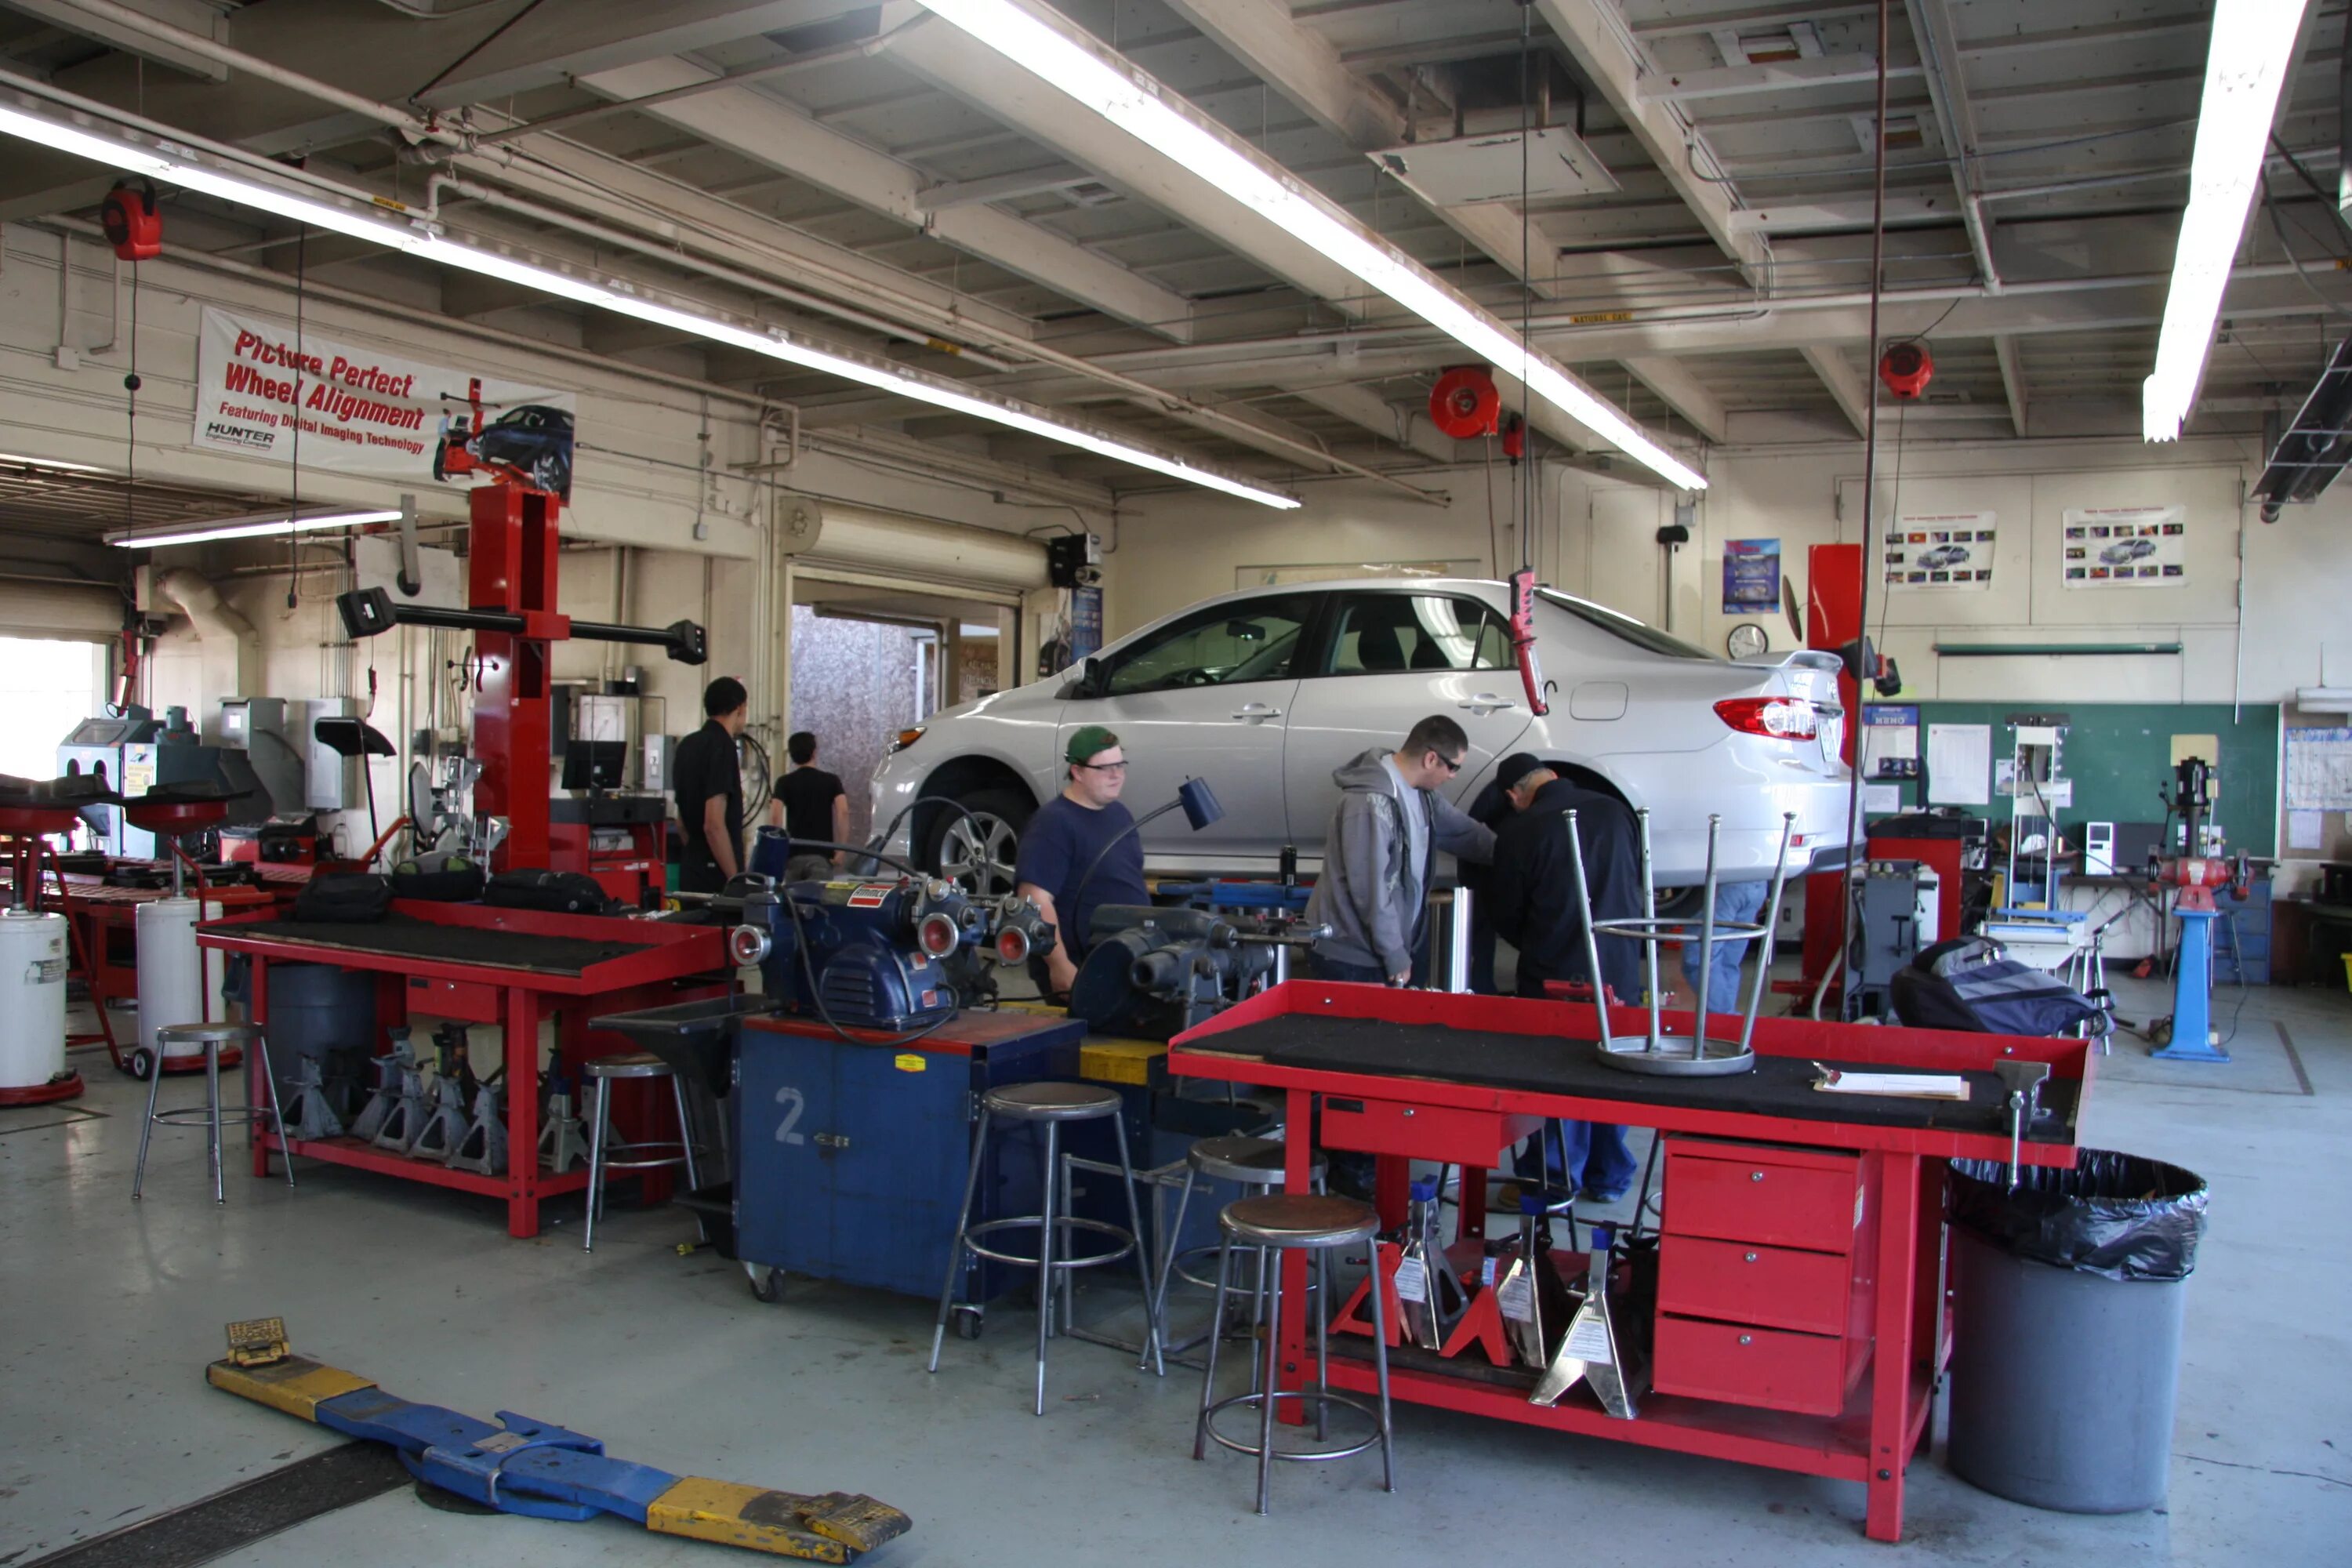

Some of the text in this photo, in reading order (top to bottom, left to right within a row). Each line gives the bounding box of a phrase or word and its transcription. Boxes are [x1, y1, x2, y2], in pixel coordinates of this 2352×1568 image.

[234, 329, 413, 399] Picture Perfect
[225, 361, 426, 430] Wheel Alignment
[205, 430, 272, 450] Engineering Company
[207, 422, 275, 444] HUNTER
[220, 401, 278, 427] Featuring
[321, 423, 363, 445] Imaging
[366, 432, 425, 455] Technology
[775, 1087, 804, 1145] 2
